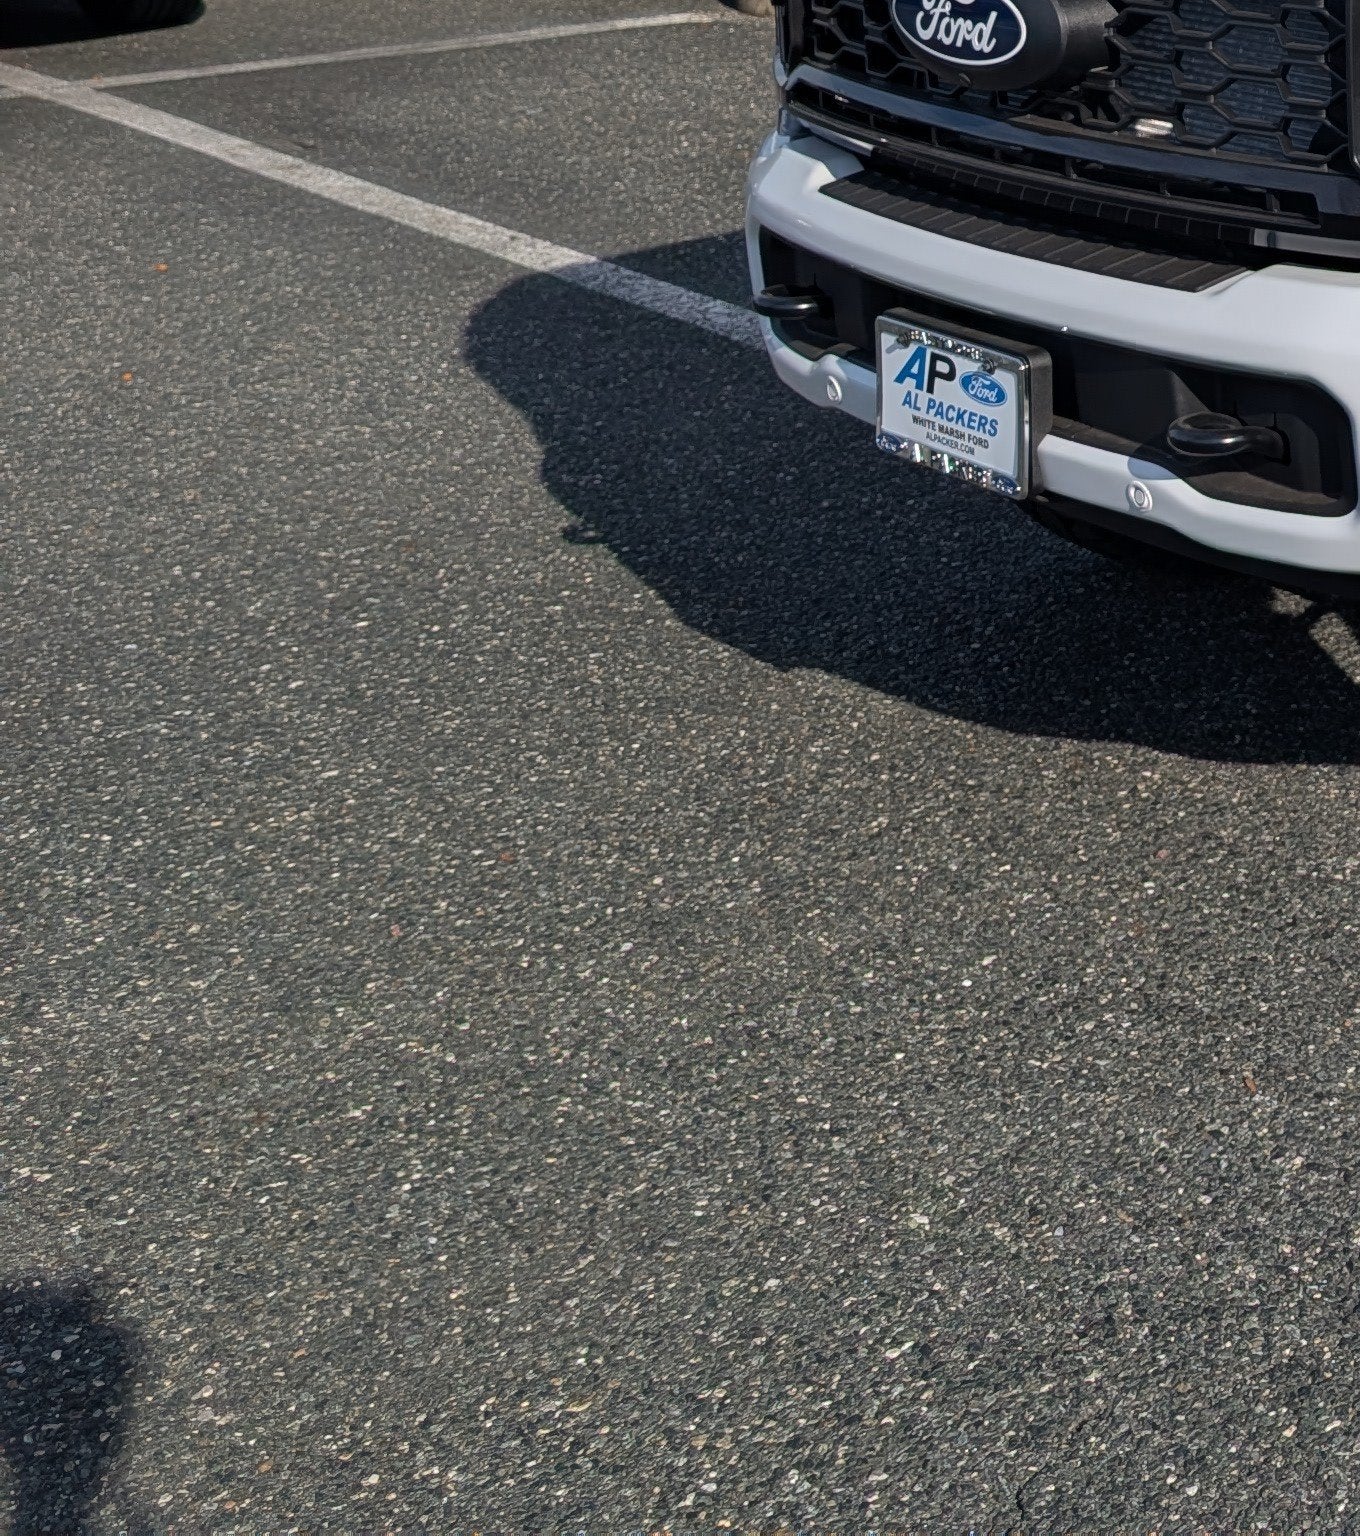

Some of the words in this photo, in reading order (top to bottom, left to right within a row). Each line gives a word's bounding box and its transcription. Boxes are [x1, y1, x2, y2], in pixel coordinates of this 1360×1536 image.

[893, 345, 957, 395] AP
[968, 375, 999, 403] Ford
[902, 390, 922, 412] AL
[926, 397, 999, 438] PACKERS
[911, 414, 936, 431] WHITE
[937, 422, 966, 443] MARSH
[967, 433, 990, 450] FORD
